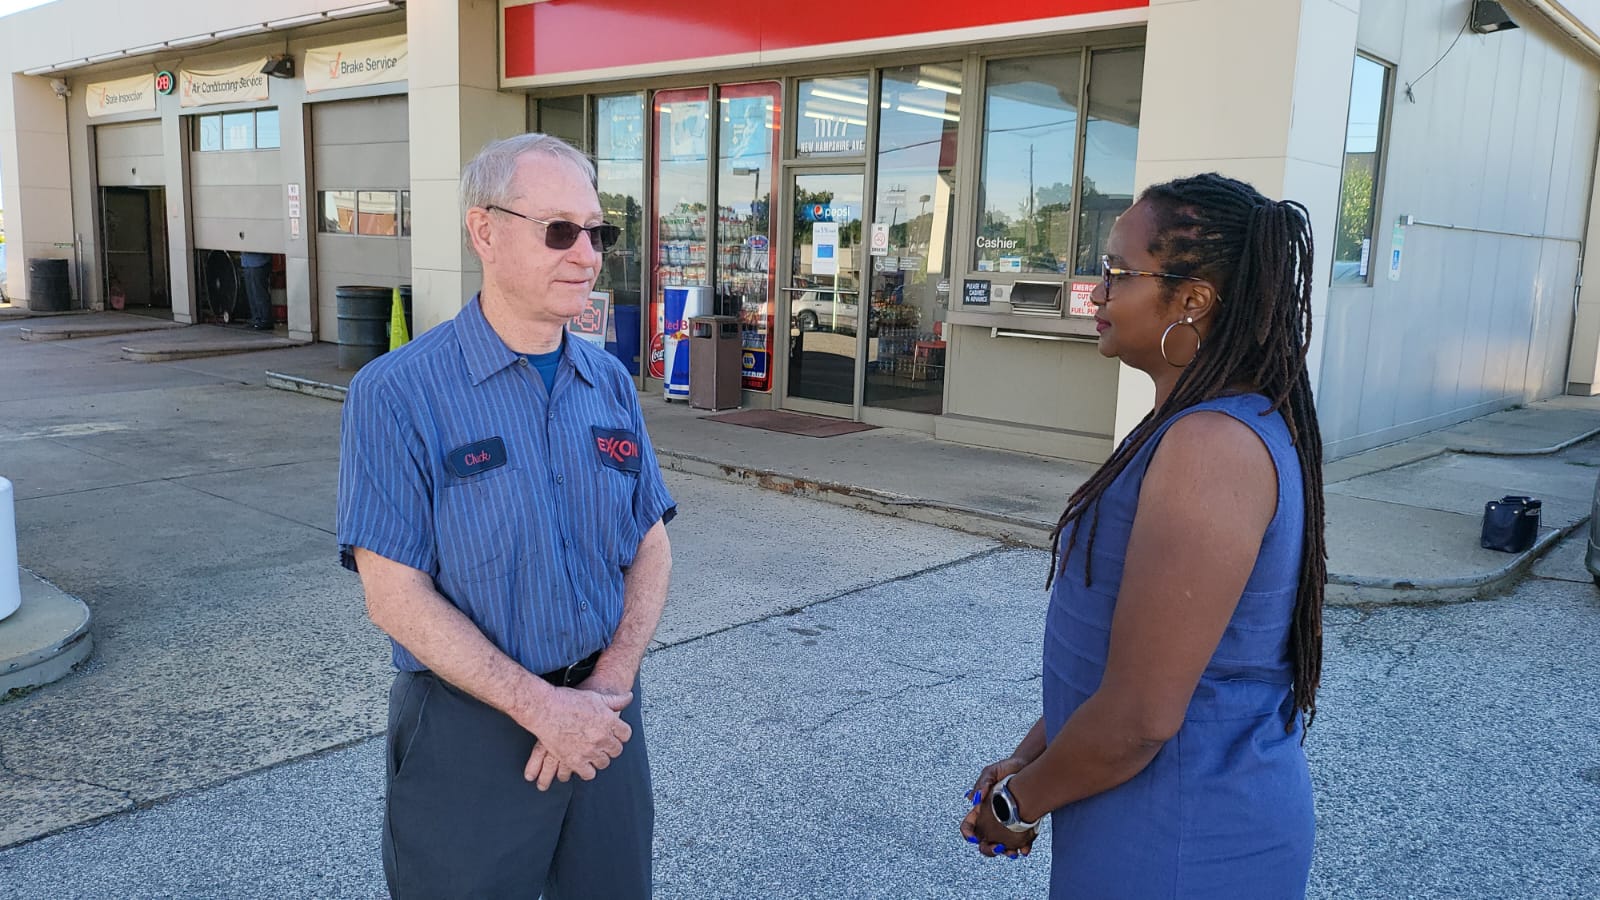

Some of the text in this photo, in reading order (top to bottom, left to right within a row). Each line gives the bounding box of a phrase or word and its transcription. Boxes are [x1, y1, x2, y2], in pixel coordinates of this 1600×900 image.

[341, 56, 398, 74] Brake Service
[192, 75, 263, 93] Air Conditioning Service
[118, 91, 143, 102] Inspection
[800, 141, 813, 153] NEW
[815, 139, 850, 152] HAMPSHIRE
[824, 206, 850, 217] pepsi
[976, 235, 1018, 249] Cashier
[597, 437, 638, 462] EXXON
[464, 450, 491, 466] Chuck
